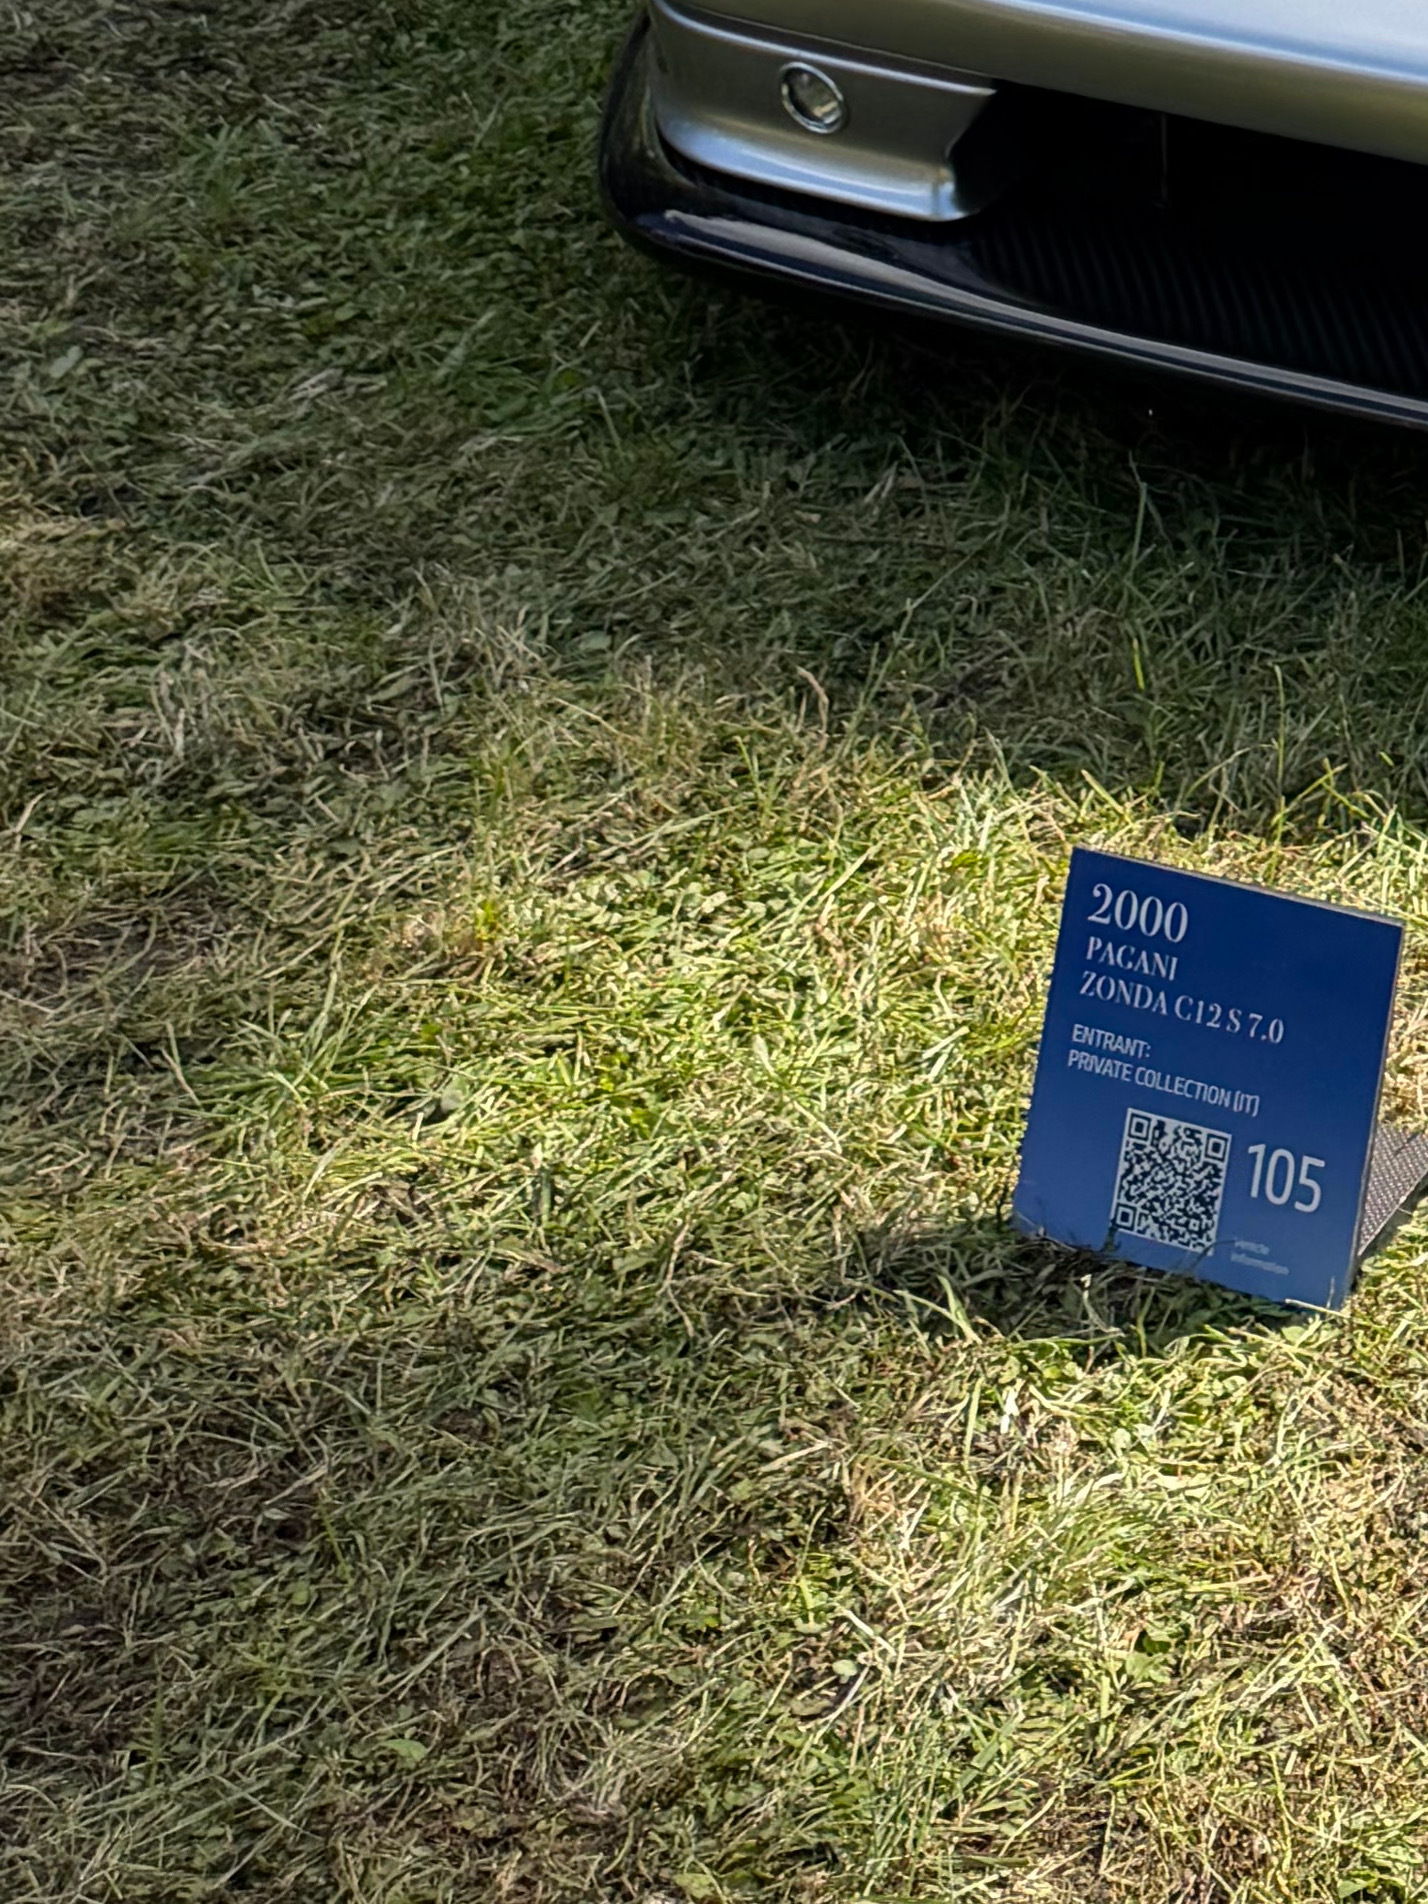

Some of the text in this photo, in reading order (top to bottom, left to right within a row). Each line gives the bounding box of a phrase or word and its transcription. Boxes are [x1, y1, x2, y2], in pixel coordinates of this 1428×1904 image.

[1087, 883, 1189, 943] 2000
[1086, 936, 1179, 981] PAGANI
[1080, 970, 1285, 1043] ZONDA C12 S 7.0
[1072, 1023, 1152, 1059] ENTRANT:
[1067, 1049, 1134, 1082] PRIVATE
[1135, 1066, 1231, 1109] COLLECTION
[1247, 1143, 1325, 1212] 105
